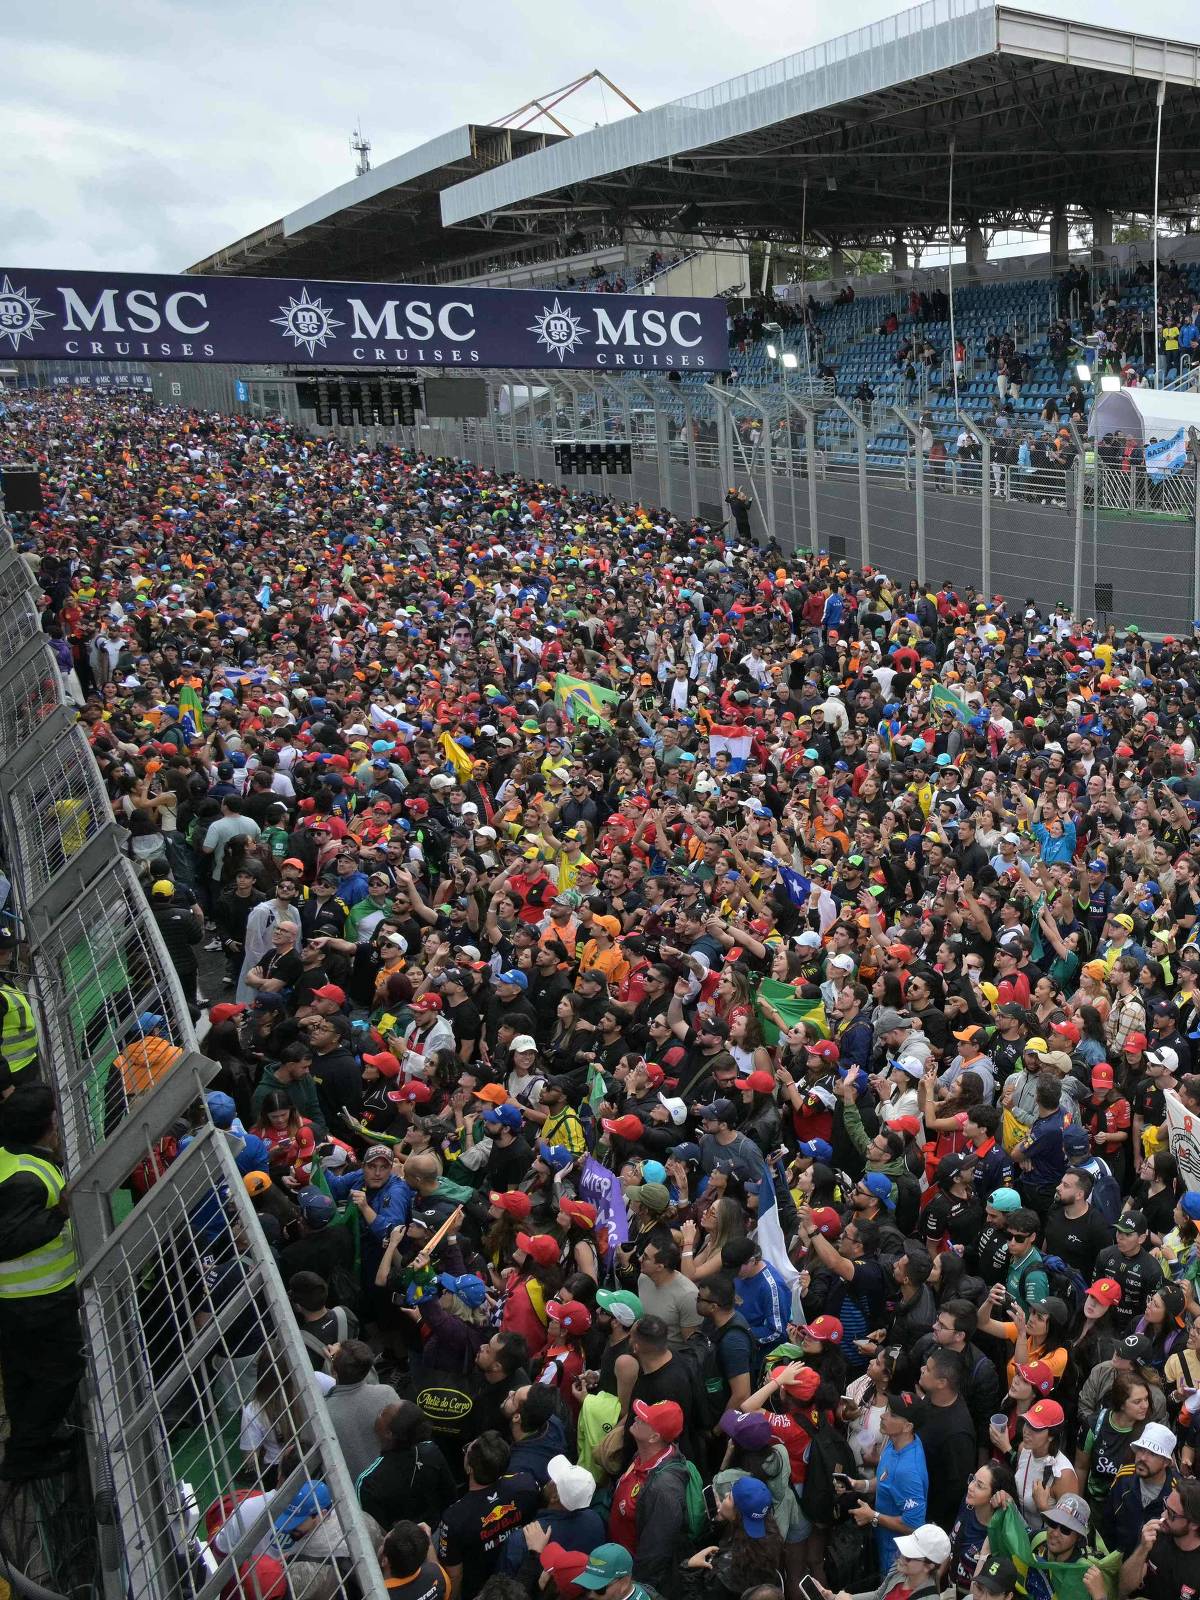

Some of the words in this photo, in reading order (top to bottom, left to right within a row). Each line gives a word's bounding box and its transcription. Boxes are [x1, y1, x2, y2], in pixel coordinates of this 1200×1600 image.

[57, 287, 210, 335] MSC
[346, 298, 476, 342] MSC
[593, 308, 703, 347] MSC
[65, 341, 215, 356] CRUISES
[353, 348, 479, 362] CRUISES
[596, 353, 705, 366] CRUISES
[988, 1561, 1001, 1576] 5
